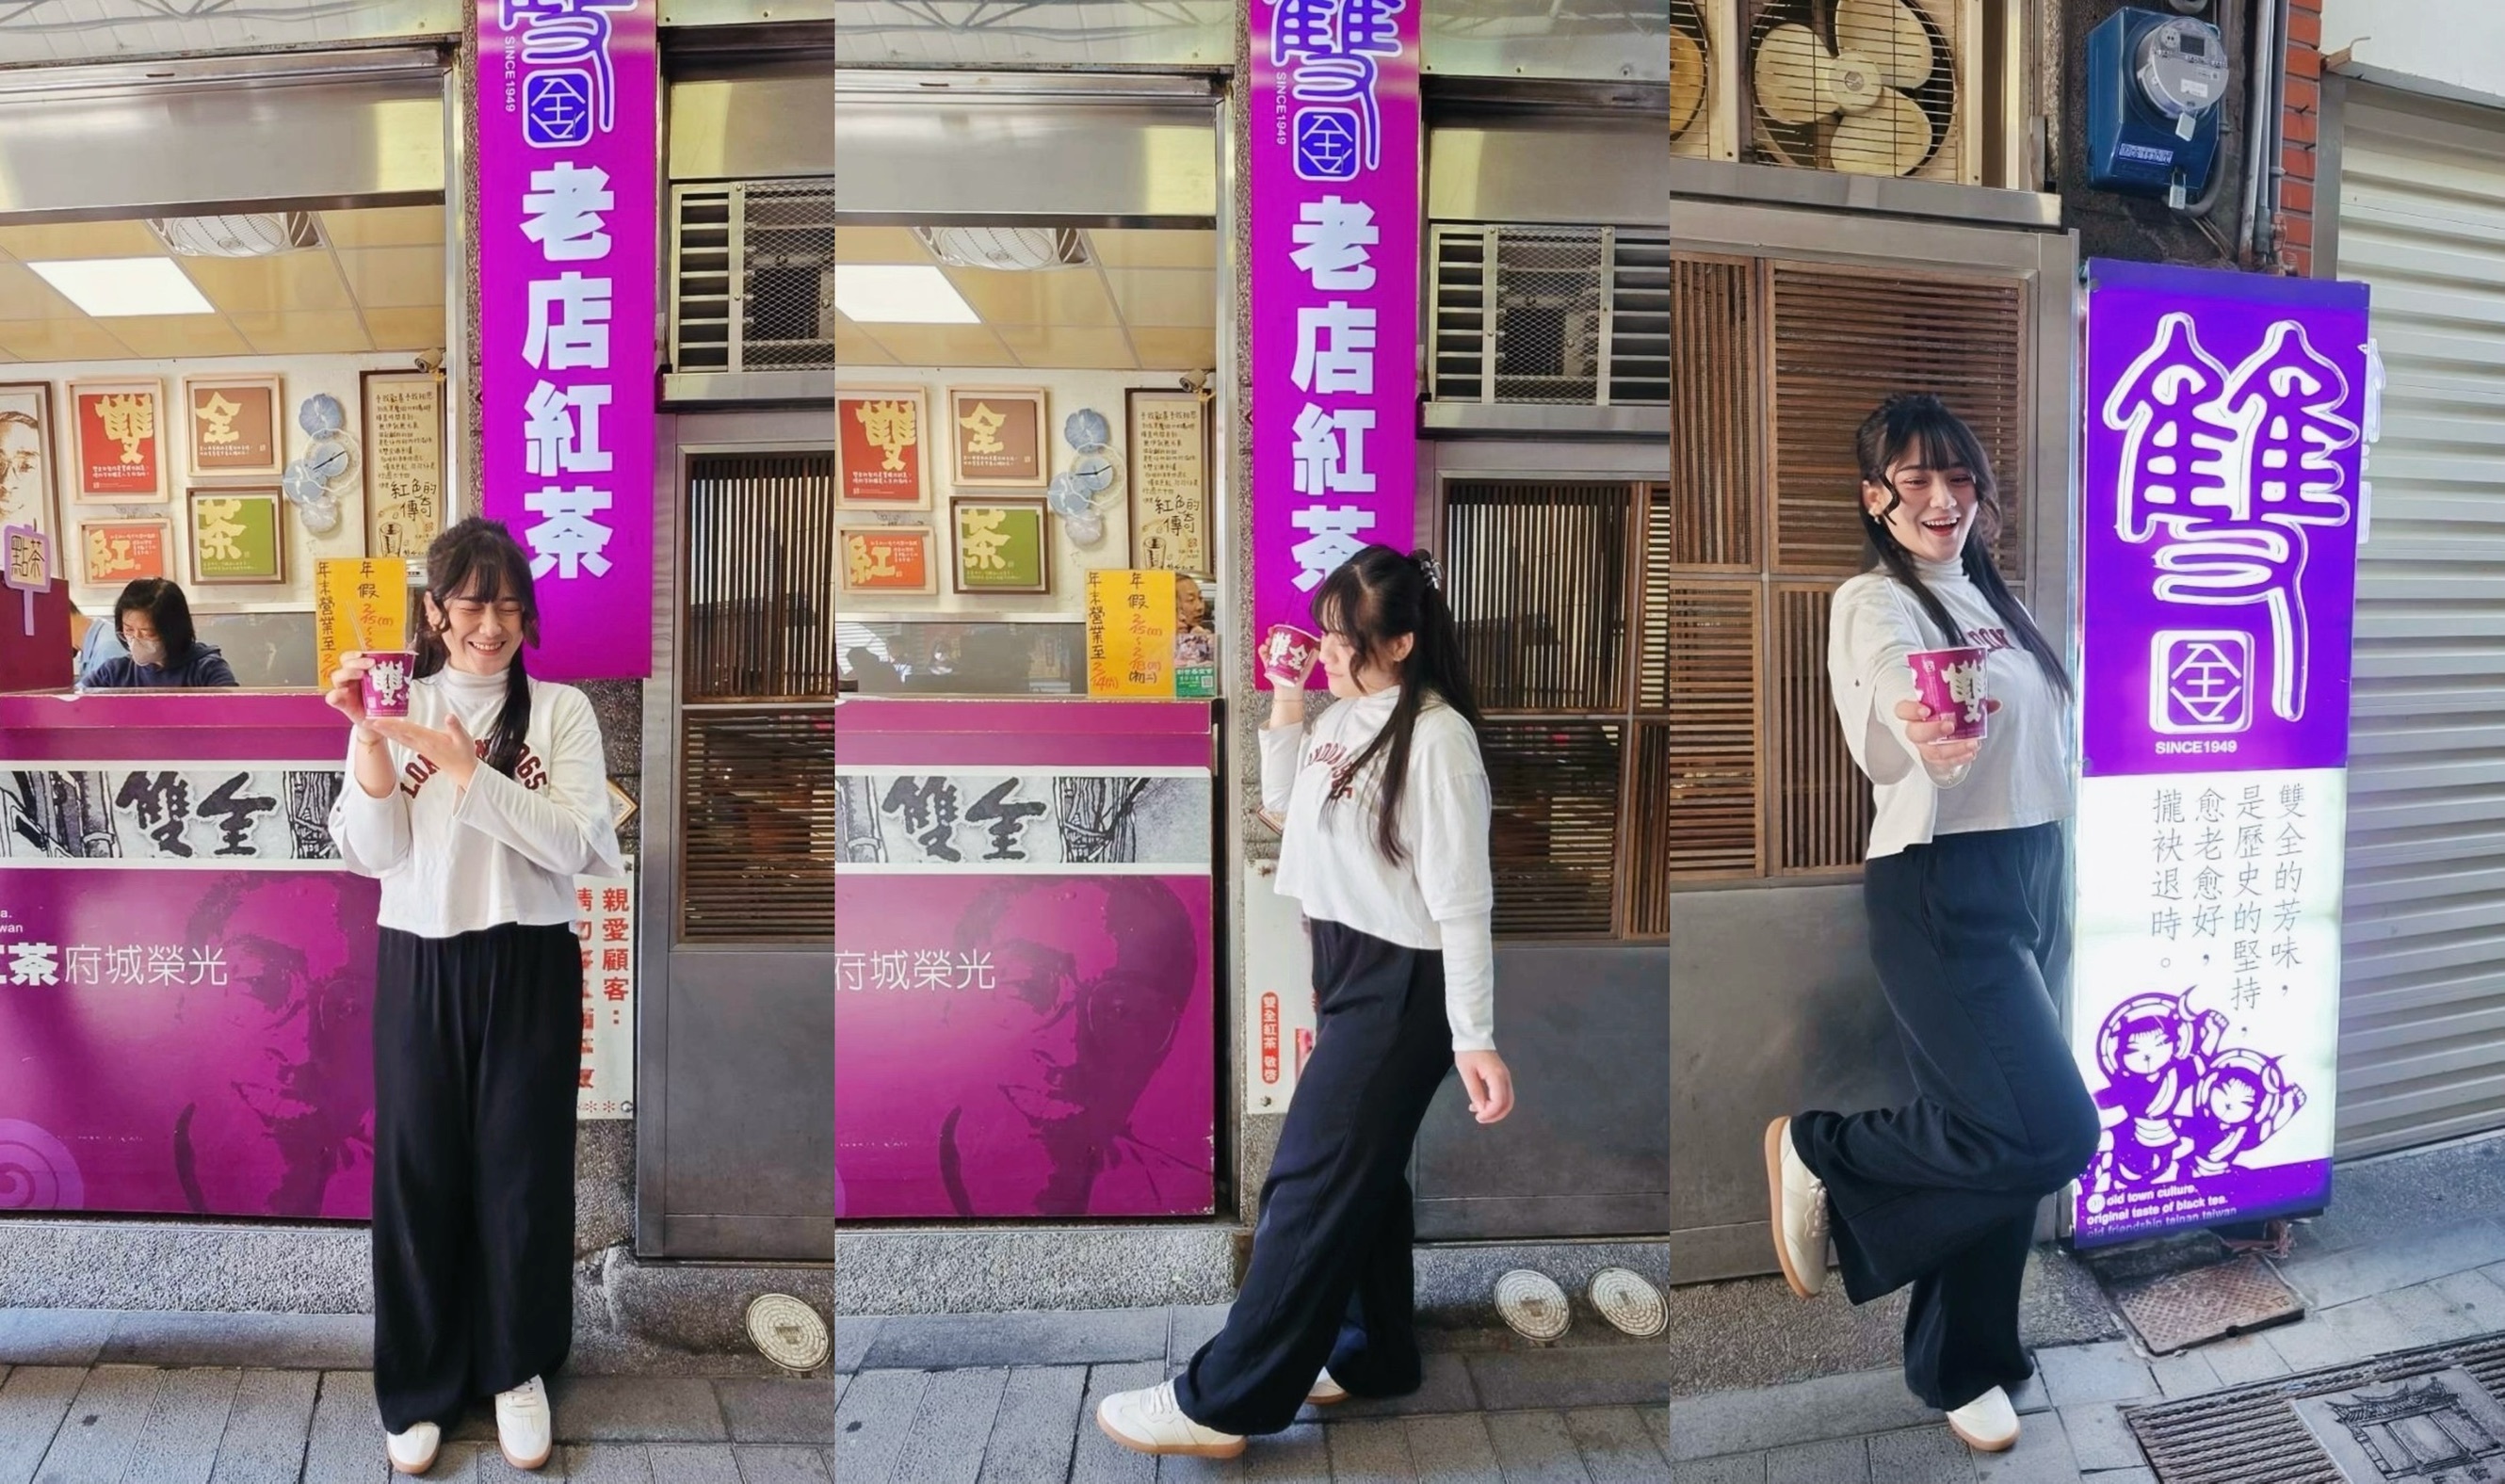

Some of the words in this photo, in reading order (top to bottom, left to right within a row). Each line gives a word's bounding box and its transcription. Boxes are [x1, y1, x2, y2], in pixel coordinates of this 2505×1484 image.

[504, 36, 516, 113] SINCE1949
[1276, 72, 1287, 146] SINCE1949
[520, 161, 615, 579] 老店紅茶
[1289, 195, 1380, 594] 老店紅茶
[94, 394, 154, 465] 雙
[855, 400, 916, 471] 雙
[89, 529, 135, 577] 紅
[197, 498, 247, 560] 茶
[848, 535, 896, 584] 紅
[961, 508, 1011, 570] 茶
[2155, 739, 2238, 756] SINCE1949
[2231, 784, 2266, 1037] 是歷史的堅持，
[2271, 783, 2306, 994] 雙全的芳味，
[65, 944, 228, 986] 府城榮光
[834, 948, 995, 992] 府城榮光
[2087, 1208, 2129, 1226] original
[2131, 1204, 2160, 1218] taste
[2162, 1200, 2175, 1214] of
[2176, 1197, 2206, 1211] black
[2207, 1195, 2229, 1206] tea.
[2107, 1194, 2125, 1206] old
[2127, 1190, 2155, 1203] town
[2157, 1184, 2199, 1199] culture.
[2087, 1226, 2105, 1239] old
